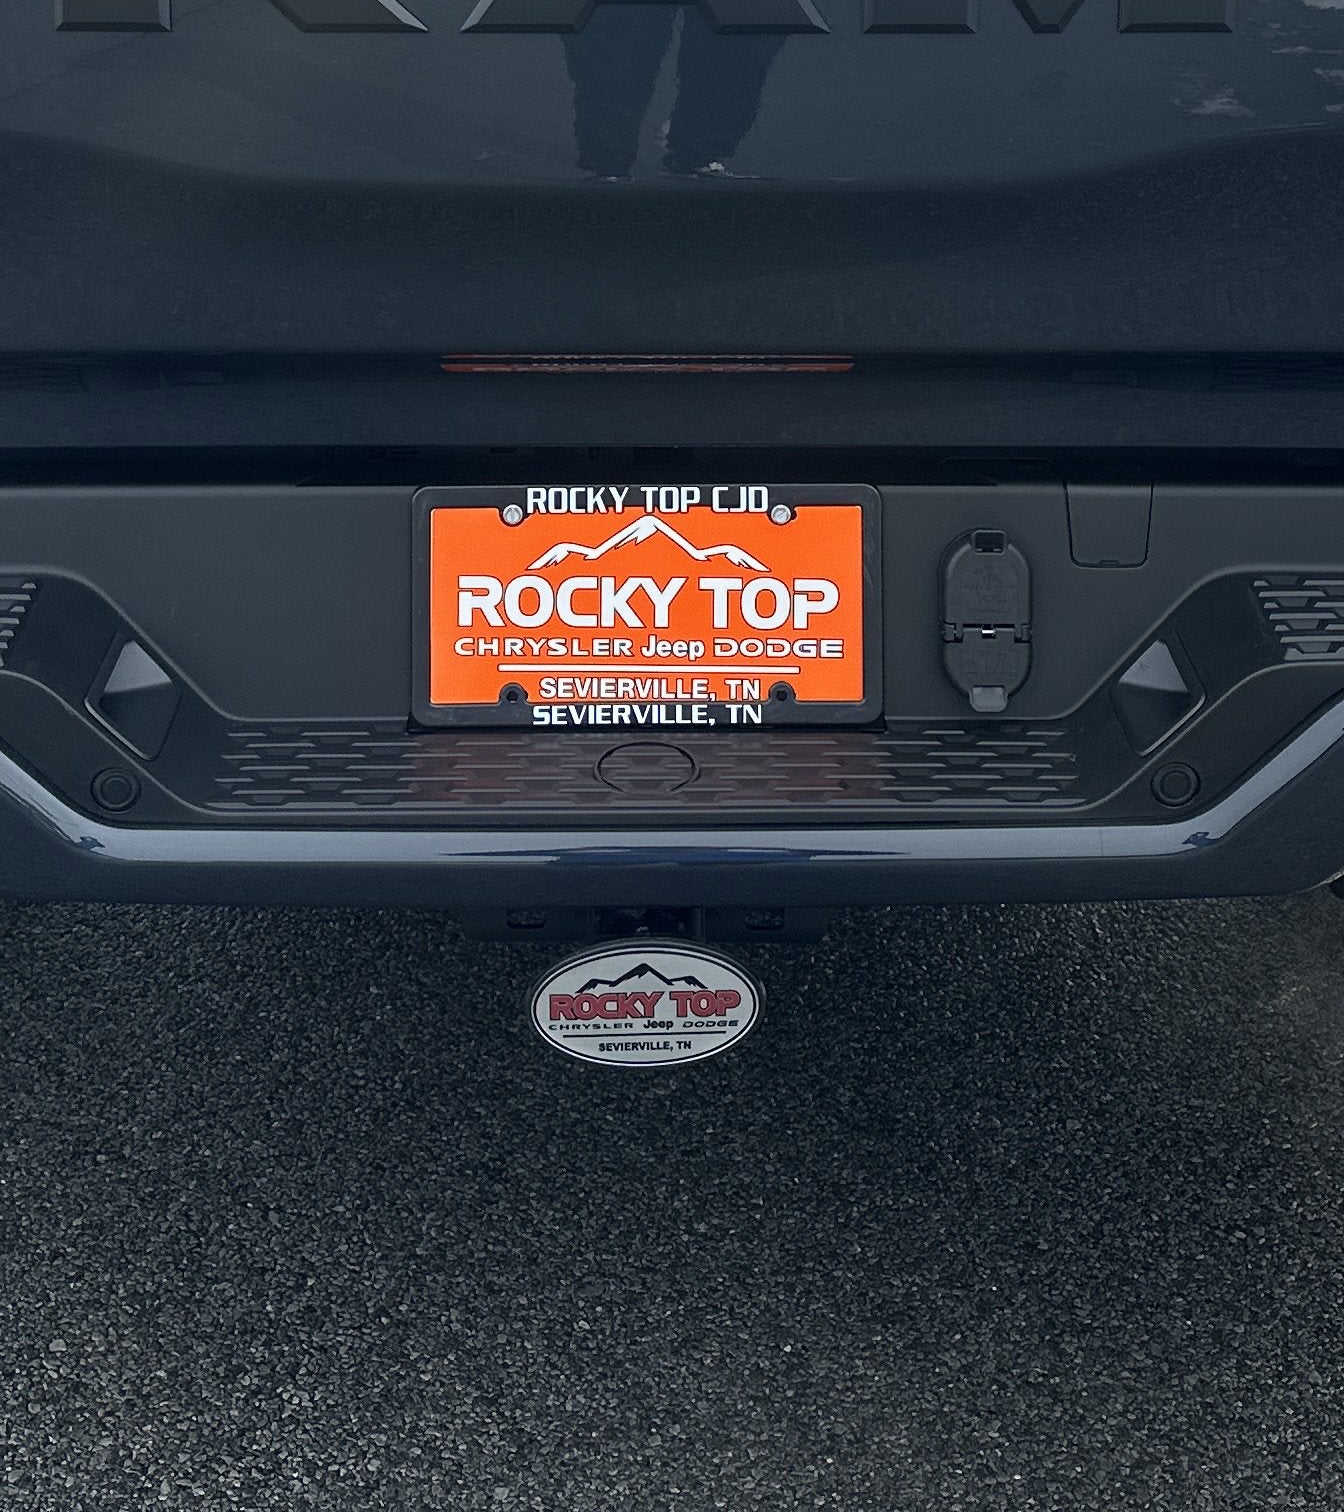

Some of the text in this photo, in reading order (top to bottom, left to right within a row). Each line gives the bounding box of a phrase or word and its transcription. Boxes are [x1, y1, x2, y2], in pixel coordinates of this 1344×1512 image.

[526, 486, 769, 514] ROCKY TOP CJD
[457, 575, 841, 631] ROCKY TOP
[453, 634, 845, 661] CHRYSLER Jeep DODGE
[539, 677, 761, 702] SEVIERVILLE, TN
[532, 704, 763, 727] SEVIERVILLE, TN
[549, 990, 742, 1021] ROCKY TOP
[548, 1019, 739, 1031] CHRYSLER Jeep DODGE
[598, 1040, 692, 1053] SEVIERVILLE, TN
